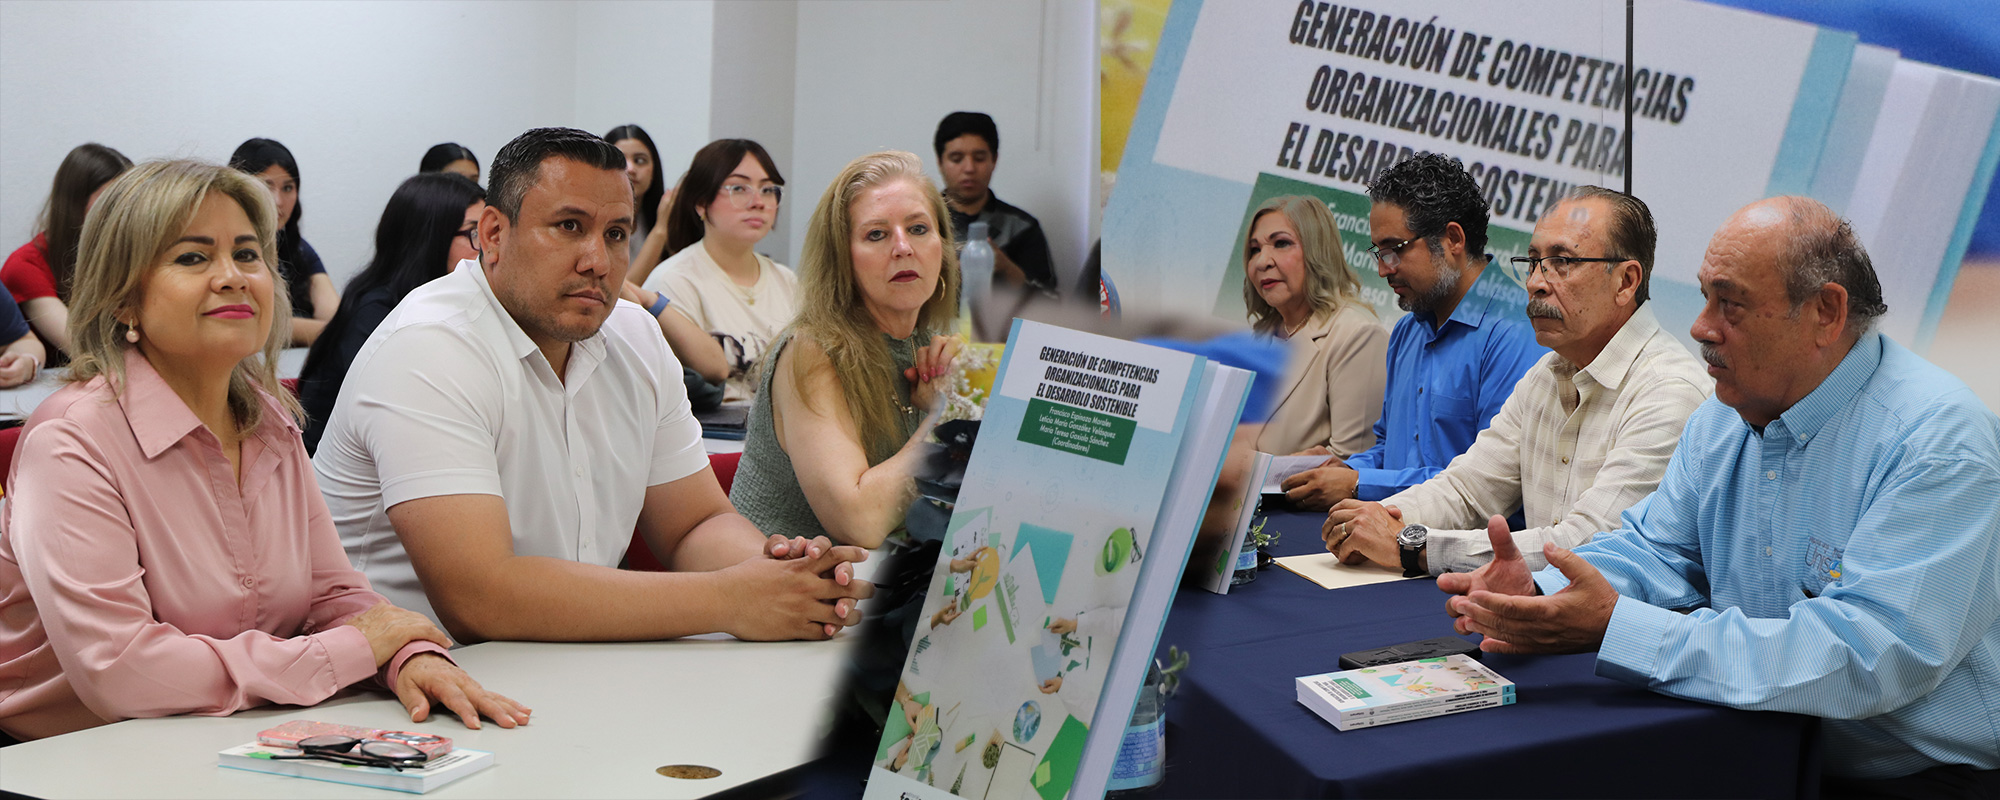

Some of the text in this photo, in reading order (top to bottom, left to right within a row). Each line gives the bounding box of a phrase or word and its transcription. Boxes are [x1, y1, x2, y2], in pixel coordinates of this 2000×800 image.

[1289, 0, 1694, 125] GENERACIÓN DE COMPETENCIAS
[1306, 65, 1633, 177] ORGANIZACIONALES PARA
[1277, 122, 1310, 170] EL
[1039, 346, 1160, 384] GENERACIÓN DE COMPETENCIAS
[1044, 365, 1141, 399] ORGANIZACIONALES PARA
[1036, 382, 1046, 397] EL
[1089, 394, 1138, 418] SOSTENIBLE
[1049, 406, 1112, 427] Francisco Espinoza Morales
[1039, 414, 1054, 424] Leticia
[1052, 436, 1090, 454] (Coordinadores)
[1054, 427, 1069, 438] Teresa
[1069, 431, 1089, 442] Gaxiola
[1089, 435, 1110, 447] Sánchez
